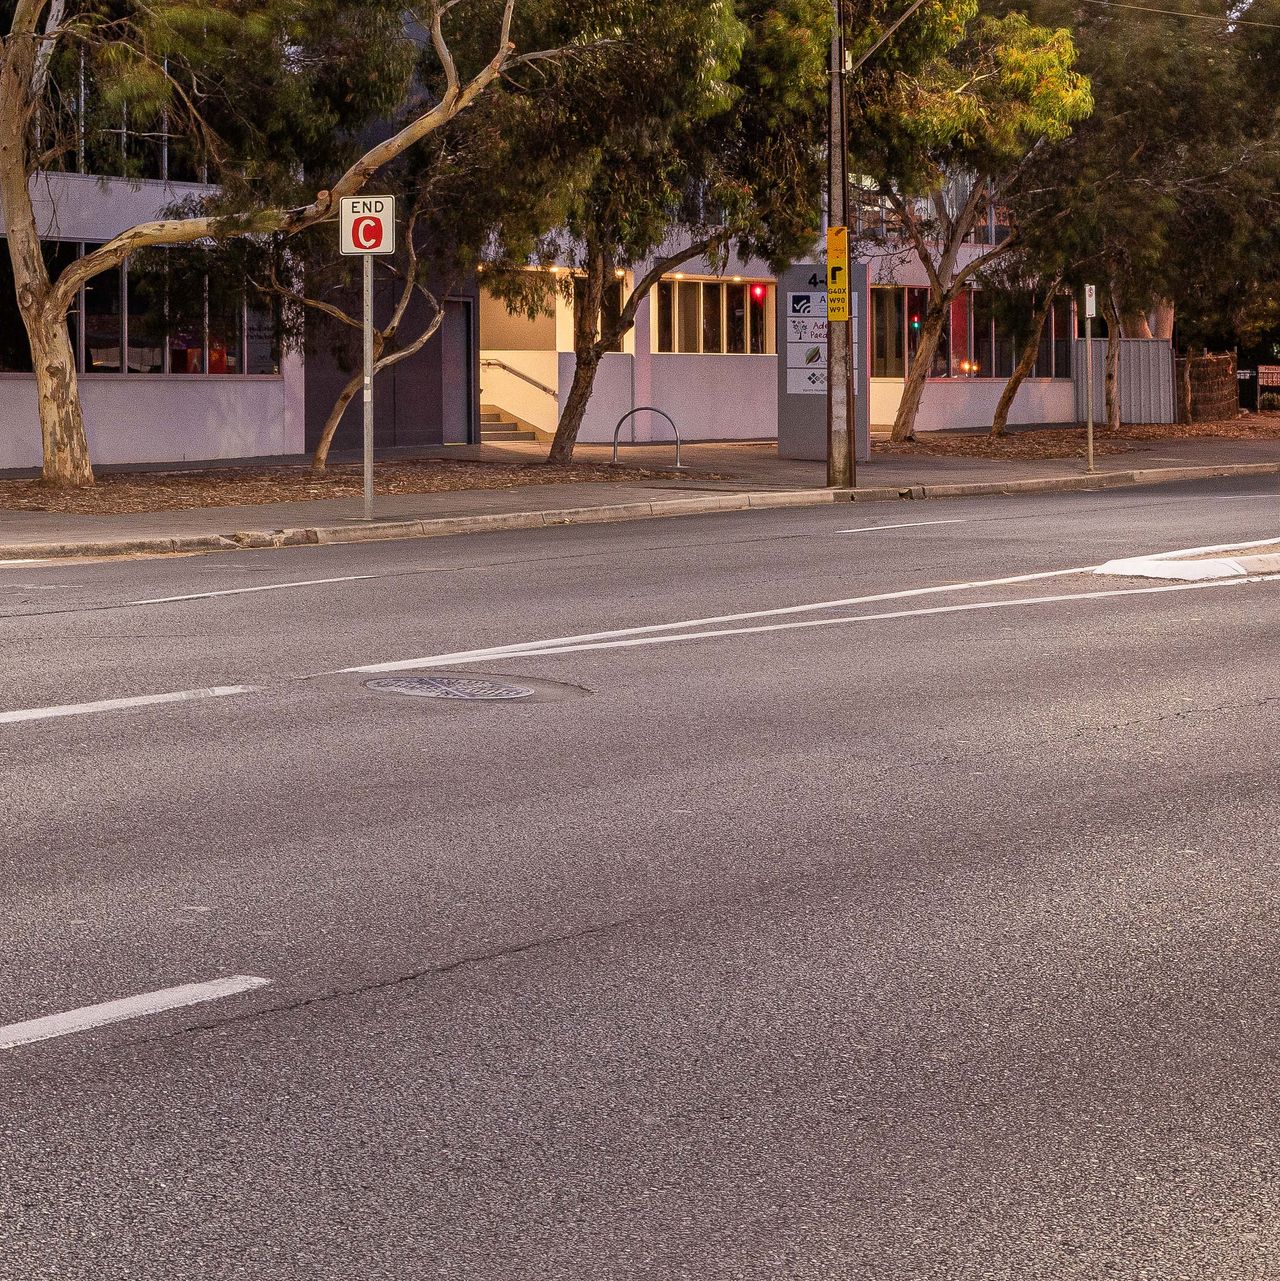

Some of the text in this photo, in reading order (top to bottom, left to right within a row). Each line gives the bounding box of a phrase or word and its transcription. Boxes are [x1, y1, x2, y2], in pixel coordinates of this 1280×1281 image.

[351, 201, 384, 213] END
[358, 219, 377, 247] C
[808, 273, 827, 287] 4-
